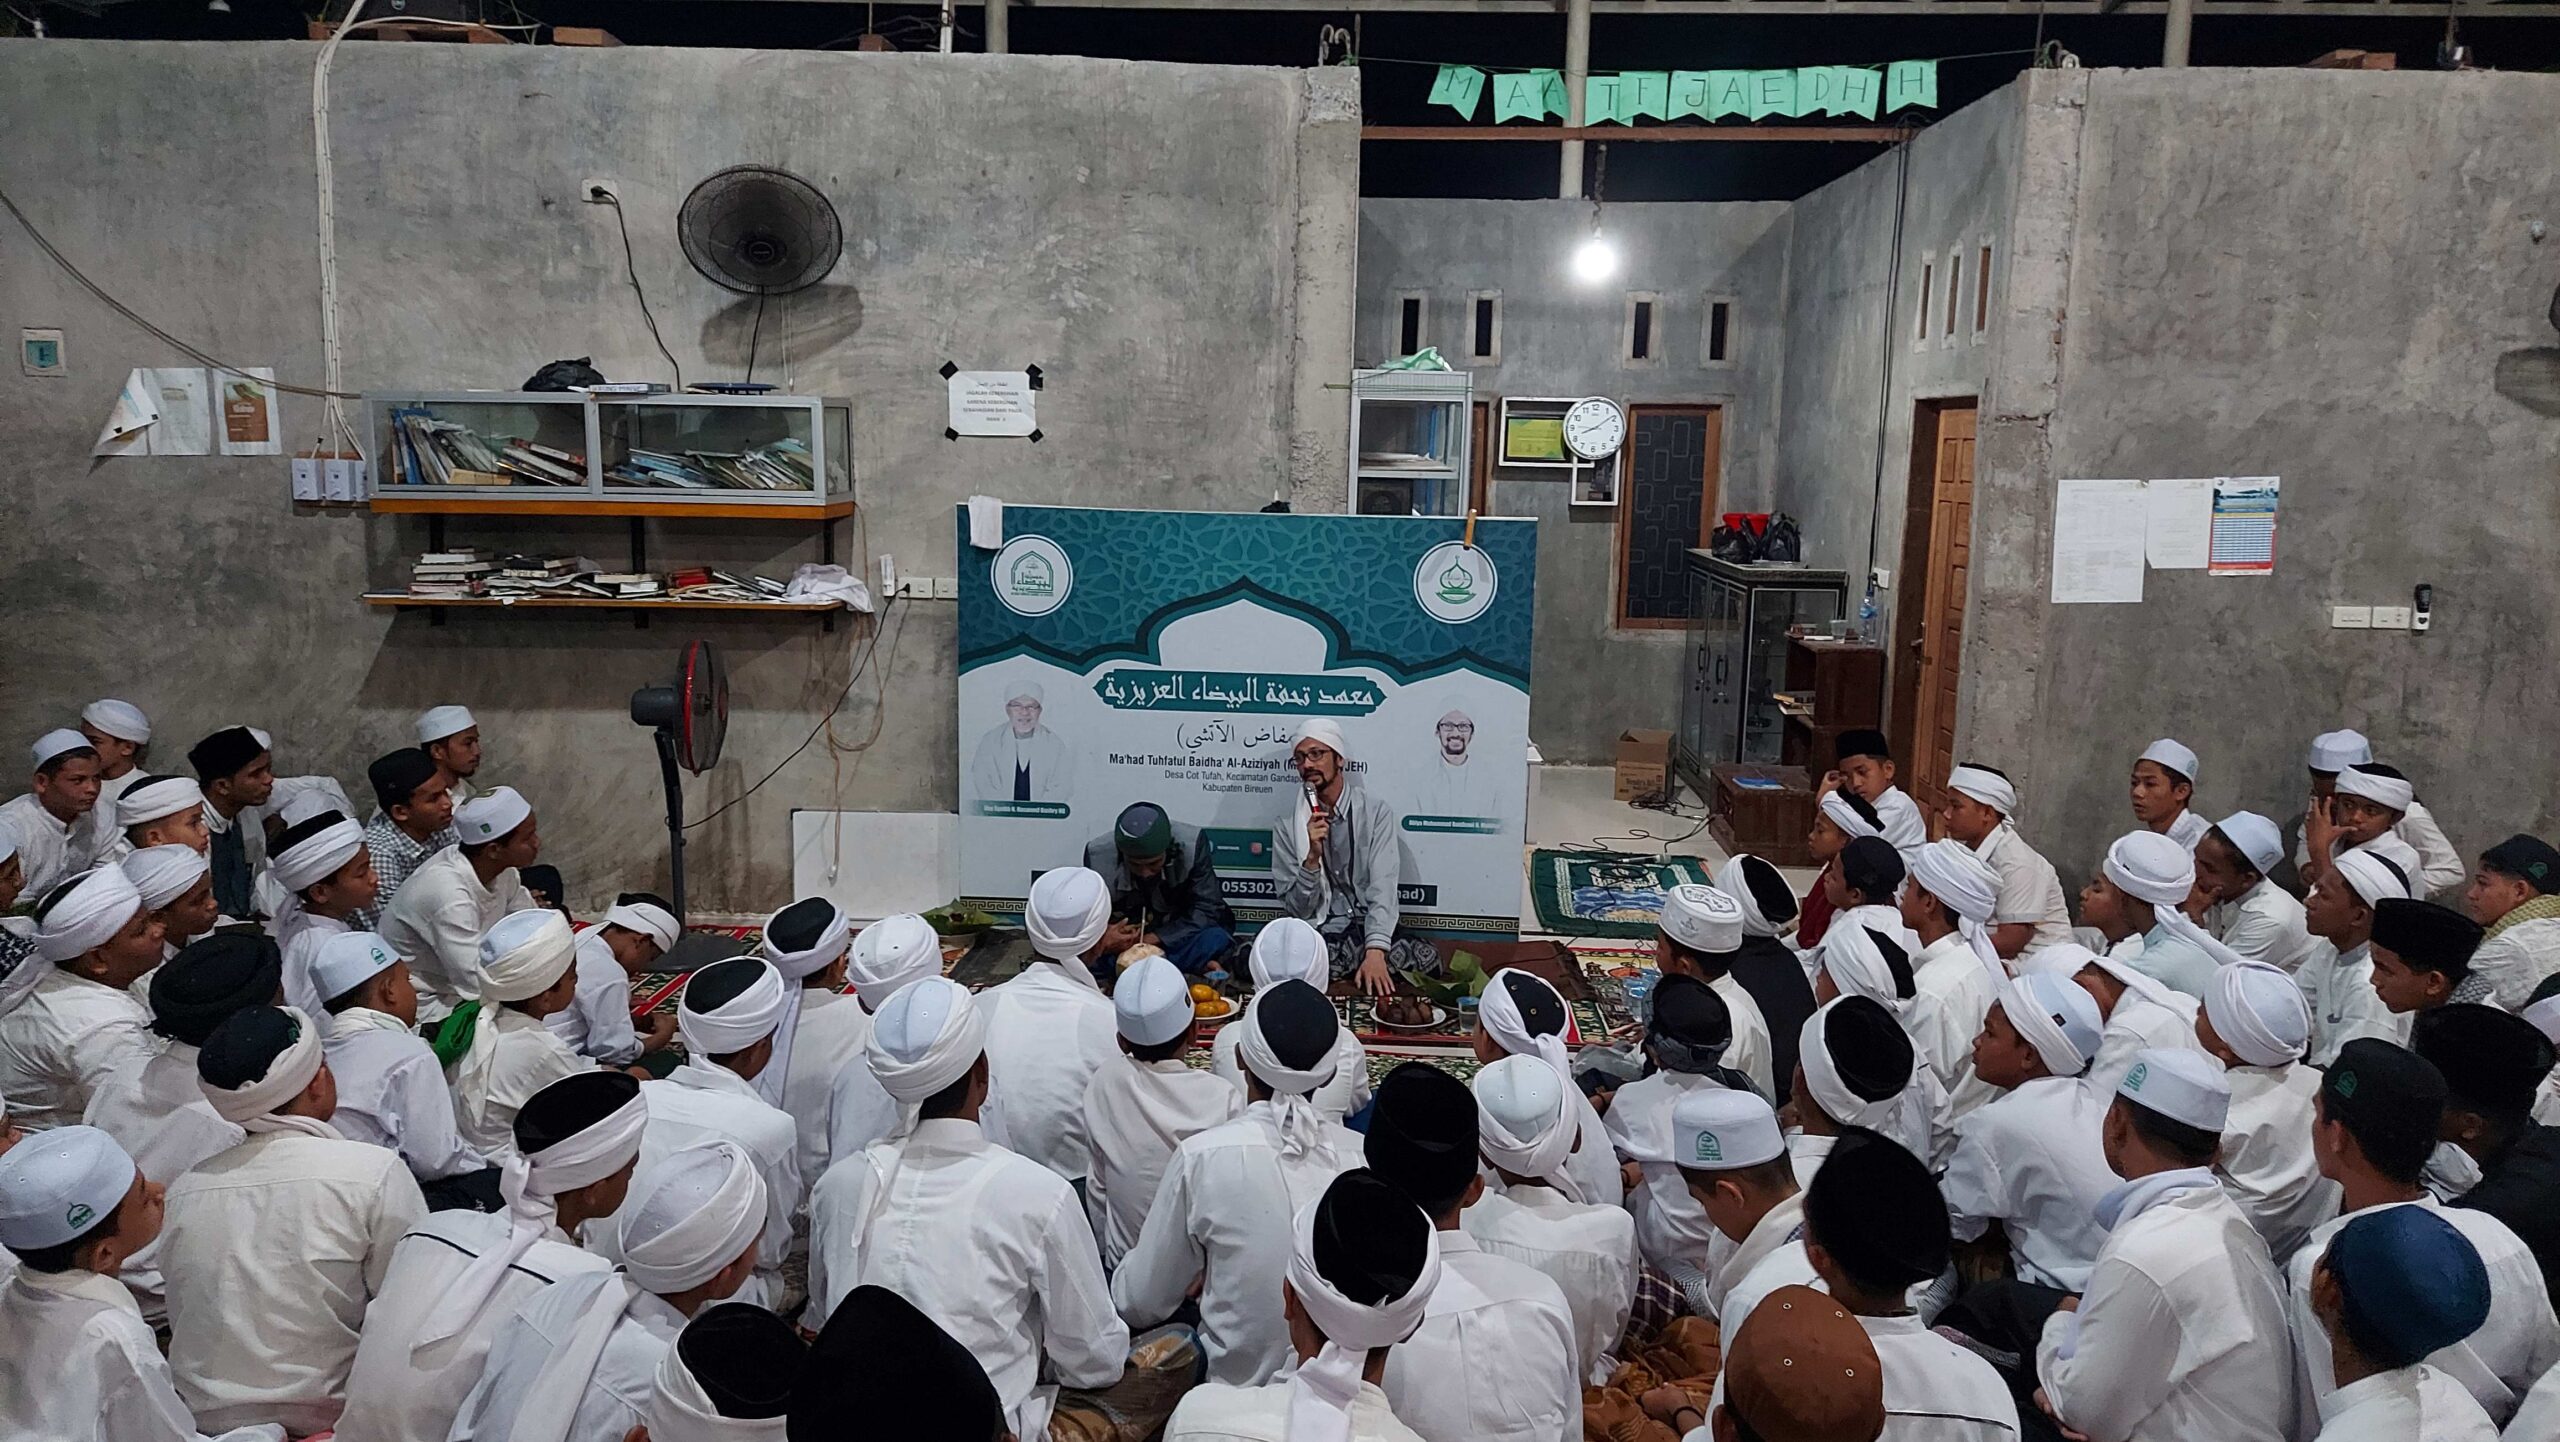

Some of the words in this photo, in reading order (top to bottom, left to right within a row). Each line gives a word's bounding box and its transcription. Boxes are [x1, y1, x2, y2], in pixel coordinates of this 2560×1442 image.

[1574, 414, 1581, 422] 10
[1105, 674, 1186, 708] العزيزية
[1191, 674, 1260, 709] البيضاء
[1265, 682, 1311, 706] تحفة
[1318, 689, 1375, 705] معهد
[1109, 753, 1145, 765] Ma'had
[1147, 754, 1186, 767] Tuhfatul
[1188, 755, 1225, 768] Baidha'
[1227, 757, 1280, 771] Al-Aziziyah
[1164, 769, 1184, 780] Desa
[1186, 770, 1200, 780] Cot
[1202, 770, 1224, 781] Tufah,
[1226, 771, 1268, 782] Kecamatan
[1202, 782, 1243, 794] Kabupaten
[1244, 783, 1273, 794] Bireuen
[1221, 880, 1278, 894] 055302
